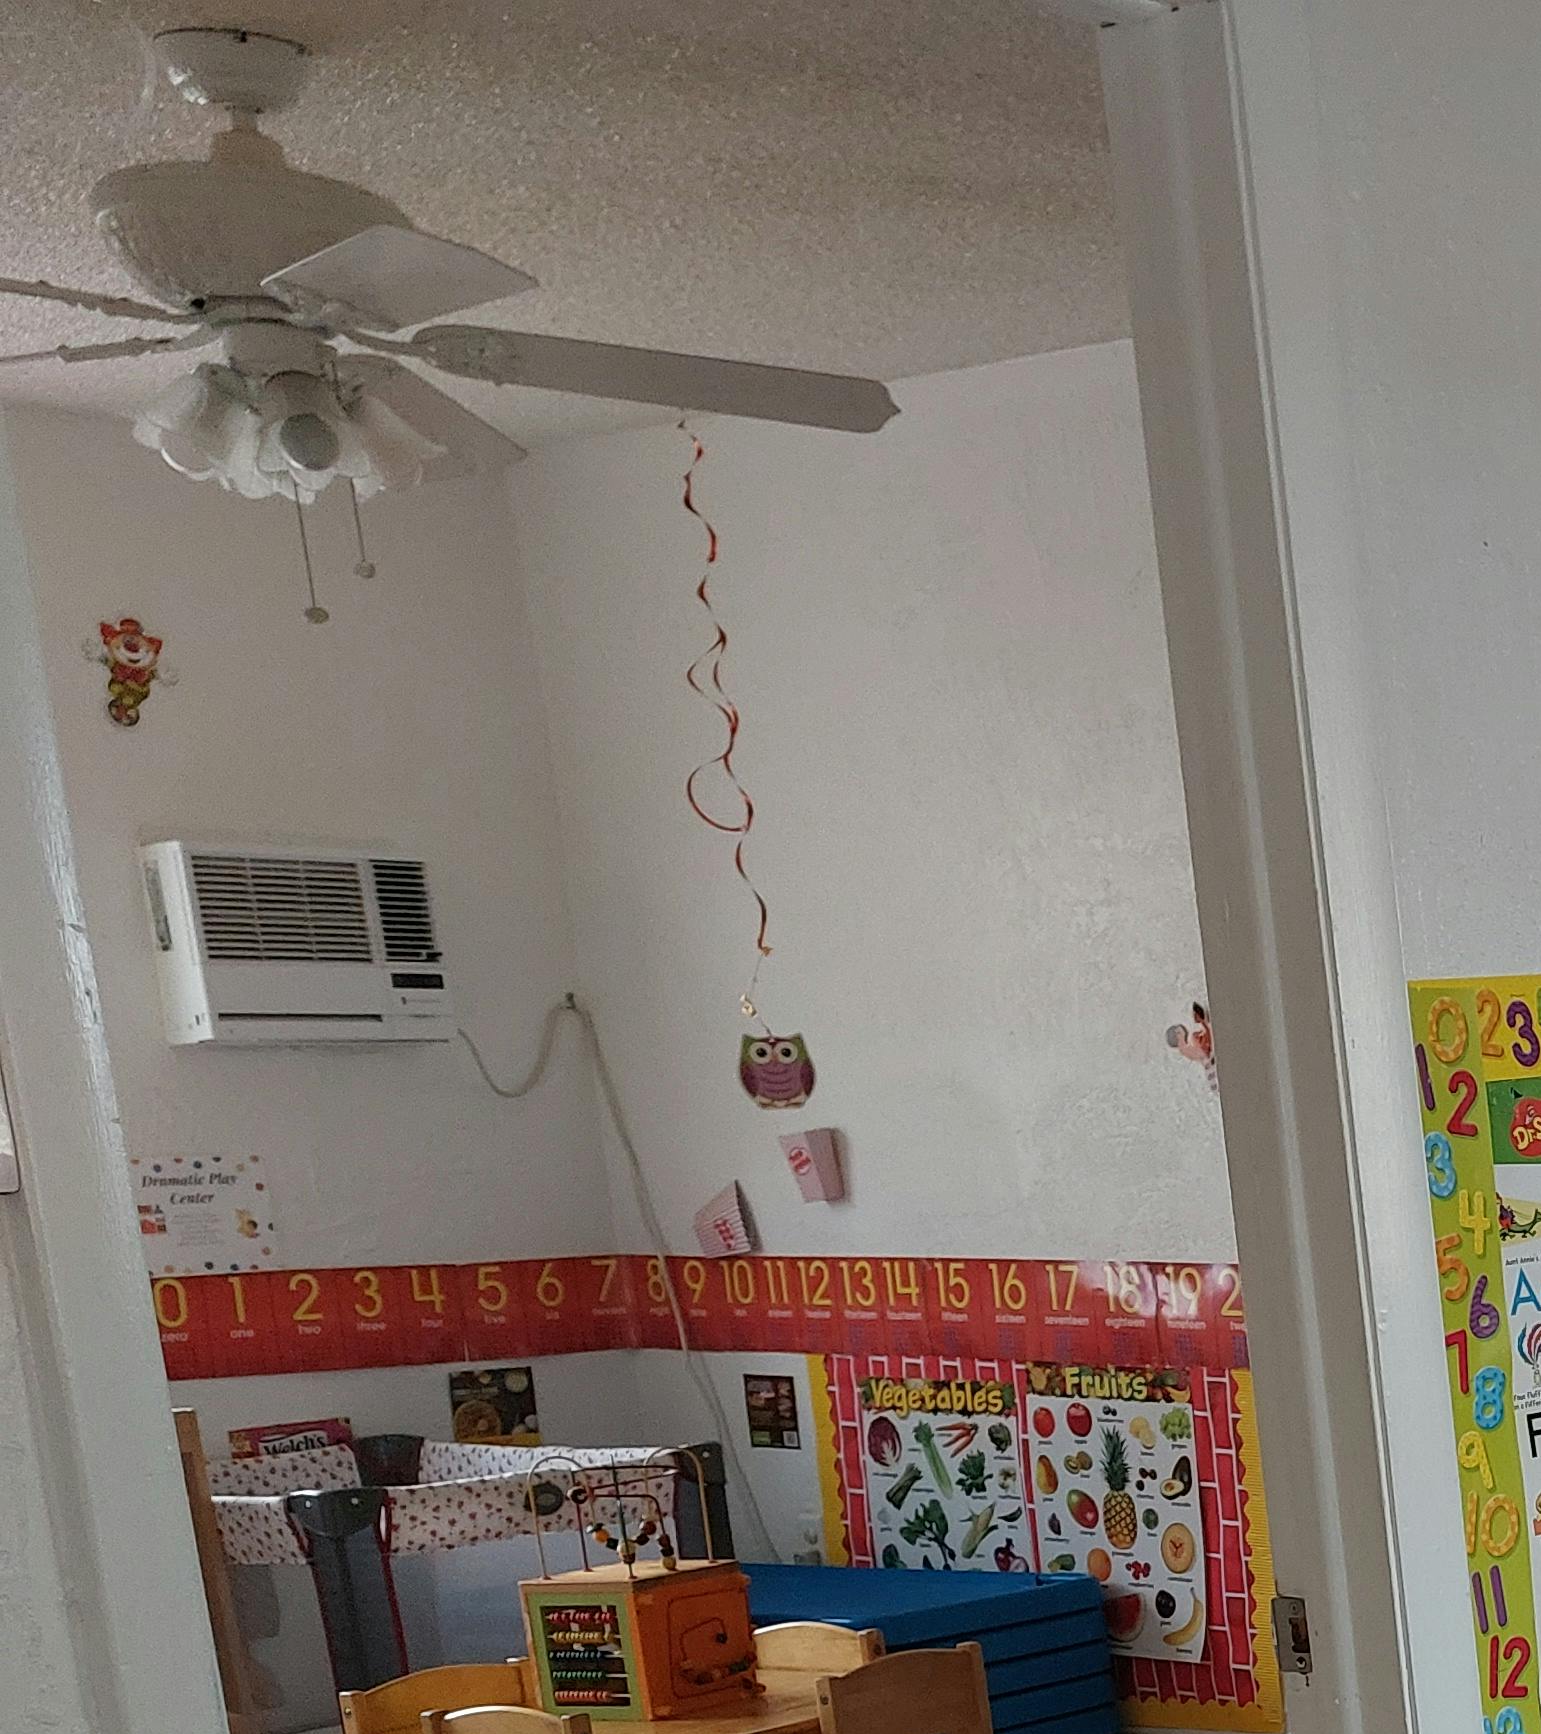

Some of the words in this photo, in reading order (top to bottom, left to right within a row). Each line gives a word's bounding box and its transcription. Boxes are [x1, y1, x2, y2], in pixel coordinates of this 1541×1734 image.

[1506, 1000, 1541, 1068] 3
[141, 1173, 207, 1189] Dramatic
[208, 1172, 238, 1188] Play
[169, 1192, 215, 1205] Center
[228, 1277, 246, 1324] 1
[289, 1272, 324, 1322] 2
[354, 1270, 384, 1318] 3
[798, 1260, 832, 1307] 12
[839, 1260, 876, 1307] 13
[882, 1260, 920, 1307] 14
[871, 1378, 1004, 1415] Vegetables
[1064, 1367, 1149, 1400] Fruits
[263, 1432, 327, 1456] Welch's
